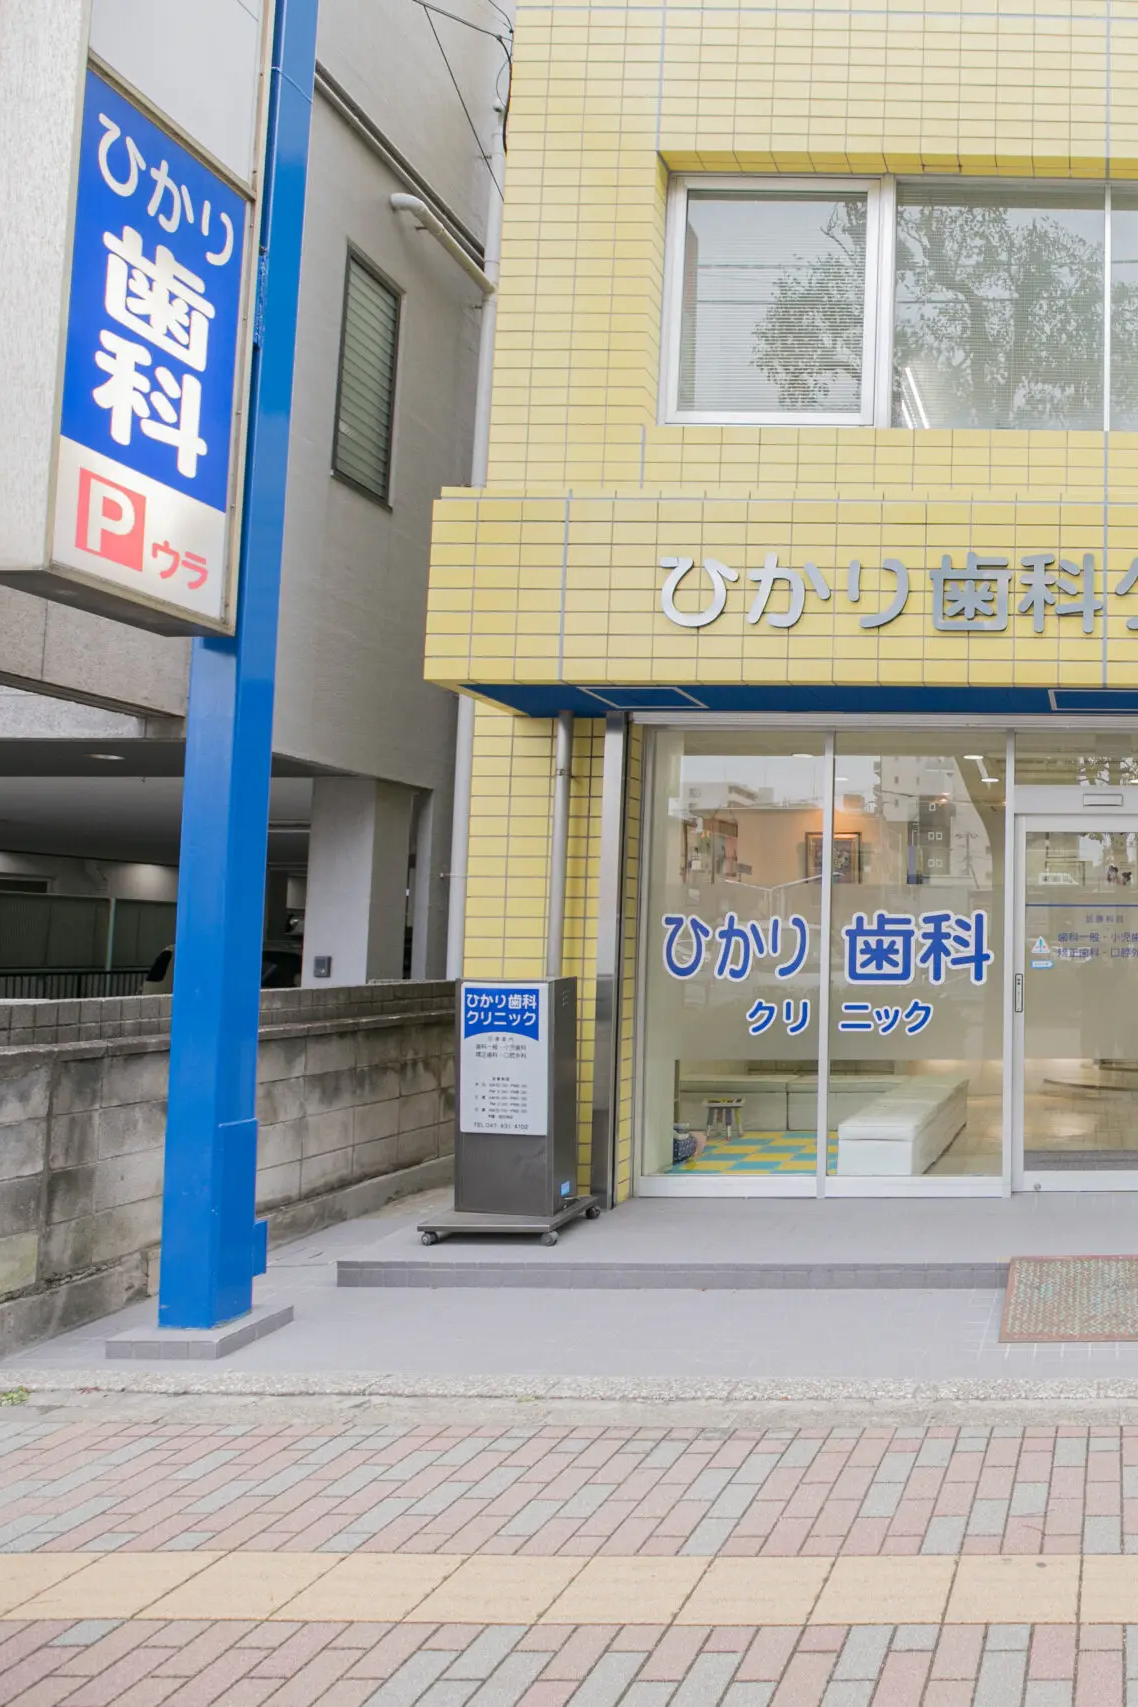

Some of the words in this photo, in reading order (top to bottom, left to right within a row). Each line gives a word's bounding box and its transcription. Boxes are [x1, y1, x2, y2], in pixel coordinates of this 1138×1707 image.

[98, 113, 234, 267] ひかり
[92, 225, 216, 479] 歯科
[87, 477, 136, 553] P
[151, 539, 209, 590] ウラ
[466, 993, 538, 1009] ひかり歯科
[466, 1011, 537, 1026] クリニック
